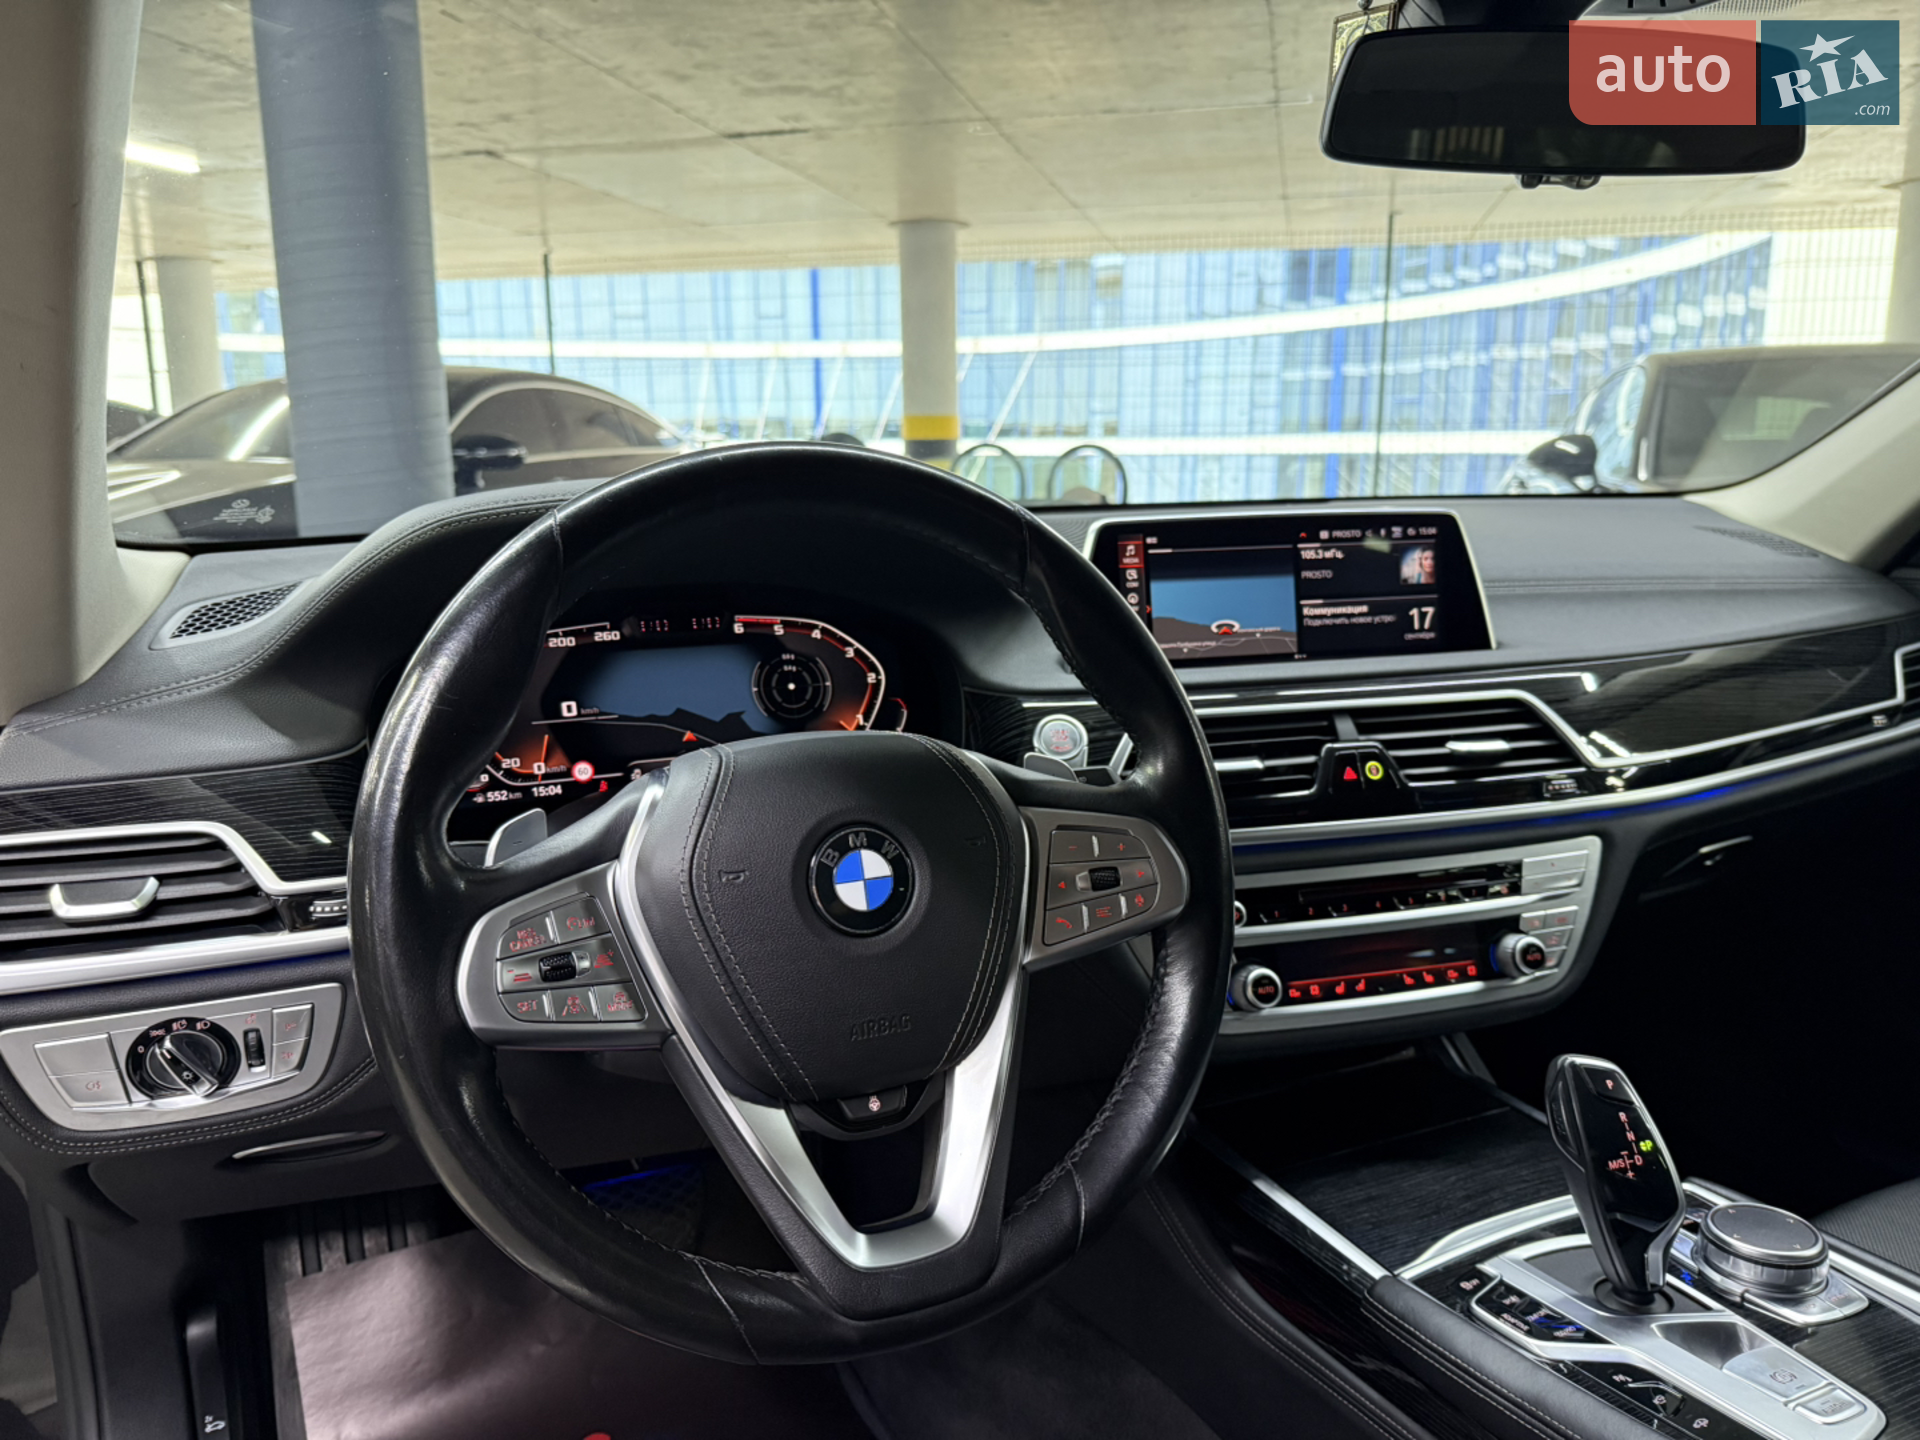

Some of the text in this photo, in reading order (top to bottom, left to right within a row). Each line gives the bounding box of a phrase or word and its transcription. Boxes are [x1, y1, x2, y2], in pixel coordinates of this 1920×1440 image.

[1331, 530, 1362, 539] PROSTO
[1418, 526, 1437, 536] 15:04
[1300, 549, 1323, 560] 105.3
[1300, 569, 1333, 580] PROSTO
[1302, 605, 1369, 617] Коммуникация
[1408, 606, 1436, 631] 17
[733, 622, 745, 635] 6
[773, 624, 785, 636] 5
[810, 628, 823, 640] 4
[547, 636, 576, 648] 200
[594, 630, 621, 642] 260
[844, 647, 855, 659] 3
[866, 672, 878, 684] 2
[560, 700, 578, 718] 0
[855, 713, 866, 727] 1
[501, 757, 521, 769] 20
[533, 761, 546, 775] 0
[578, 766, 590, 777] 60
[486, 790, 509, 803] 552
[531, 784, 564, 798] 15:04
[821, 831, 900, 868] BMW
[517, 999, 538, 1013] SET
[850, 1014, 911, 1042] AIRBAG
[1605, 1079, 1615, 1090] P
[1618, 1111, 1628, 1123] R
[1626, 1130, 1636, 1142] N
[1607, 1158, 1626, 1171] M/S
[1634, 1155, 1644, 1167] D
